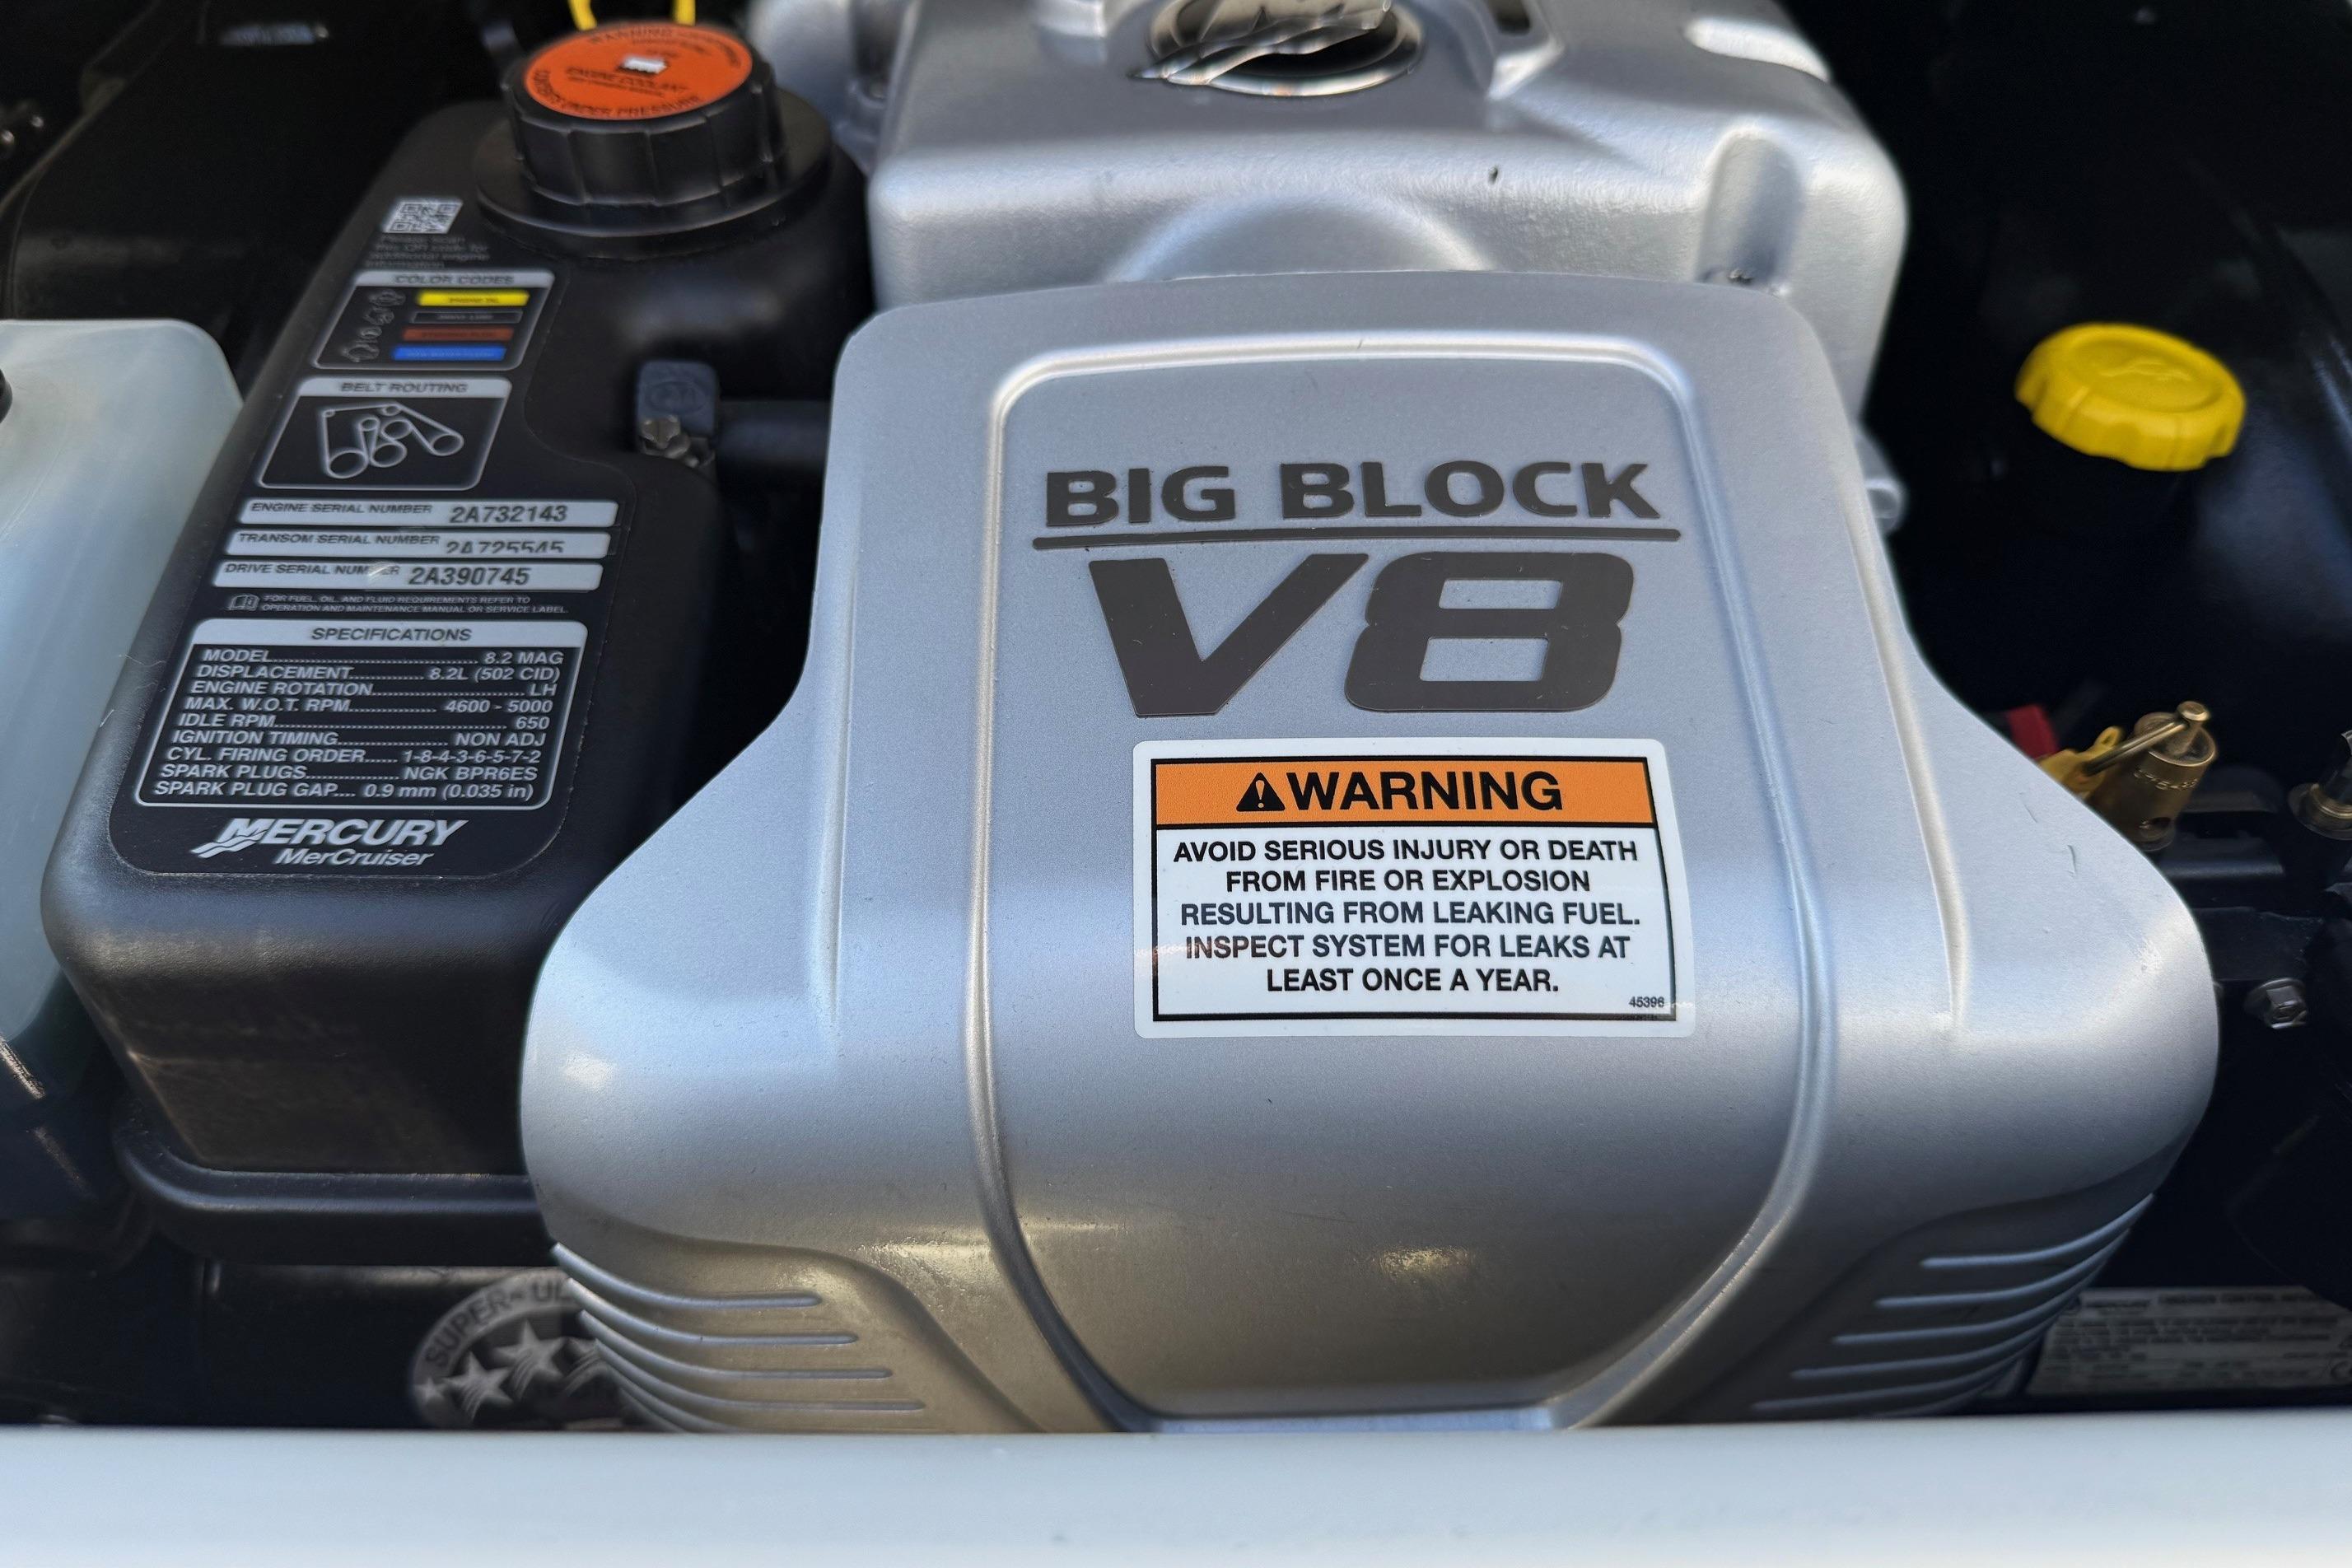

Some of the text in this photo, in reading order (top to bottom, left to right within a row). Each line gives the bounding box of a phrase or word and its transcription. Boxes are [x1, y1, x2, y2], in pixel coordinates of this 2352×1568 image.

[340, 381, 469, 394] BELT ROUTING
[1046, 460, 1661, 527] BIG BLOCK
[251, 503, 568, 524] ENGINE SERIAL NUMBER 2A732143
[239, 534, 312, 544] TRANSOM
[316, 534, 371, 544] SERIAL
[376, 535, 440, 545] NUMBER
[225, 563, 273, 574] DRIVE
[275, 564, 330, 575] SERIAL
[408, 566, 531, 586] 2A390745
[311, 627, 472, 642] SPECIFICATIONS
[1088, 552, 1634, 716] V8
[485, 651, 513, 664] 8.2
[518, 651, 563, 665] MAG
[429, 667, 469, 679] 8.2L
[474, 667, 515, 682] (502
[520, 667, 561, 682] CID)
[191, 682, 268, 694] ENGINE
[530, 684, 556, 696] LH
[185, 698, 233, 711] MAX.
[242, 698, 302, 712] W.O.T.
[446, 700, 489, 712] 4600
[507, 700, 553, 712] 5000
[180, 714, 225, 727] IDLE
[516, 716, 550, 730] 650
[172, 730, 263, 744] IGNITION
[455, 733, 500, 746] NON
[505, 733, 546, 746] ADJ
[167, 748, 212, 761] CYL.
[217, 749, 288, 762] FIRING
[404, 750, 541, 763] 1-8-4-3-6-5-7-2
[161, 764, 230, 777] SPARK
[404, 767, 448, 780] NGK
[455, 767, 538, 781] BPR6ES
[155, 782, 225, 796] SPARK
[231, 782, 292, 796] PLUG
[363, 783, 394, 797] 0.9
[400, 786, 437, 797] mm
[442, 784, 502, 800] (0.035
[506, 784, 534, 800] in)
[1287, 771, 1562, 811] WARNING
[191, 819, 469, 857] MERCURY
[274, 848, 434, 866] MerCruiser
[1174, 840, 1637, 863] AVOID SERIOUS INJURY OR DEATH
[1226, 870, 1589, 892] FROM FIRE OR EXPLOSION
[1181, 902, 1640, 925] RESULTING FROM LEAKING FUEL.
[1186, 935, 1630, 959] INSPECT SYSTEM FOR LEAKS AT
[1267, 968, 1558, 992] LEAST ONCE A YEAR.
